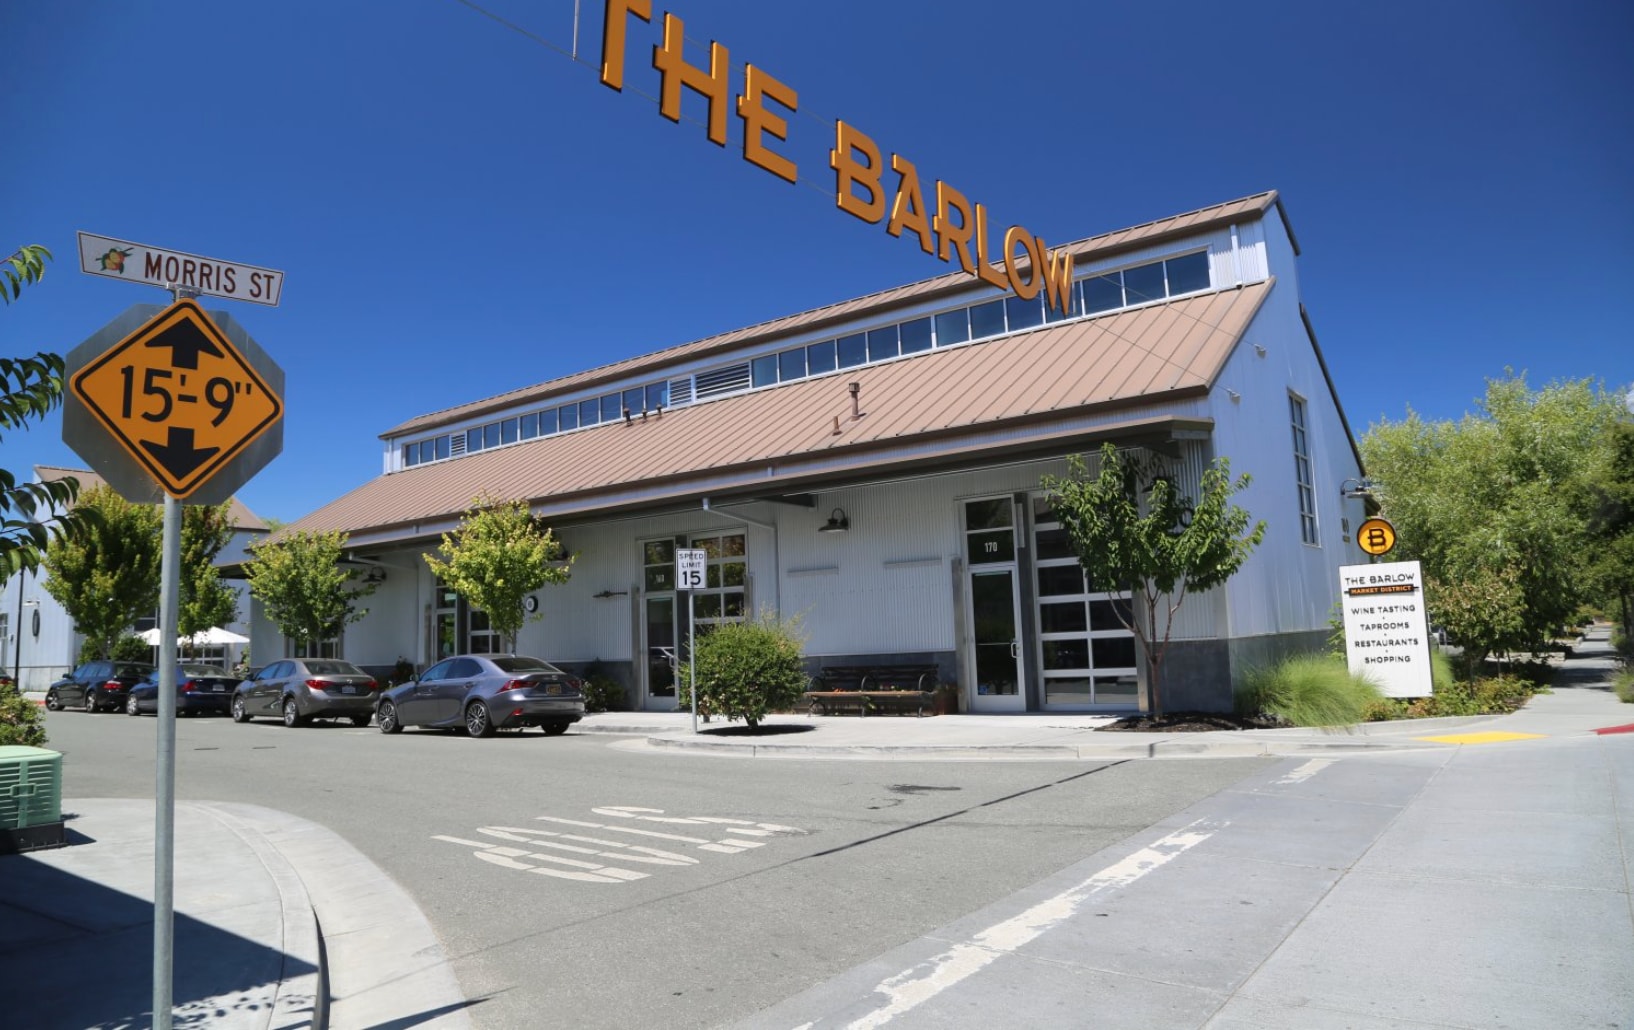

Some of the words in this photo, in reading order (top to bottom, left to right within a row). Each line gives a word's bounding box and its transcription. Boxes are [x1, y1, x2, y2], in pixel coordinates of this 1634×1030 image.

[600, 0, 798, 184] THE
[829, 118, 1074, 316] BARLOW
[144, 251, 236, 294] MORRIS
[250, 272, 275, 300] ST
[1367, 528, 1386, 546] B
[985, 542, 998, 552] 170
[682, 571, 701, 585] 15
[1345, 576, 1365, 585] THE
[1369, 573, 1415, 584] BARLOW
[1351, 607, 1375, 615] WINE
[1378, 605, 1416, 613] TASTING
[1360, 622, 1410, 630] TAPROOMS
[1354, 638, 1419, 648] RESTAURANTS
[1364, 655, 1411, 663] SHOPPING
